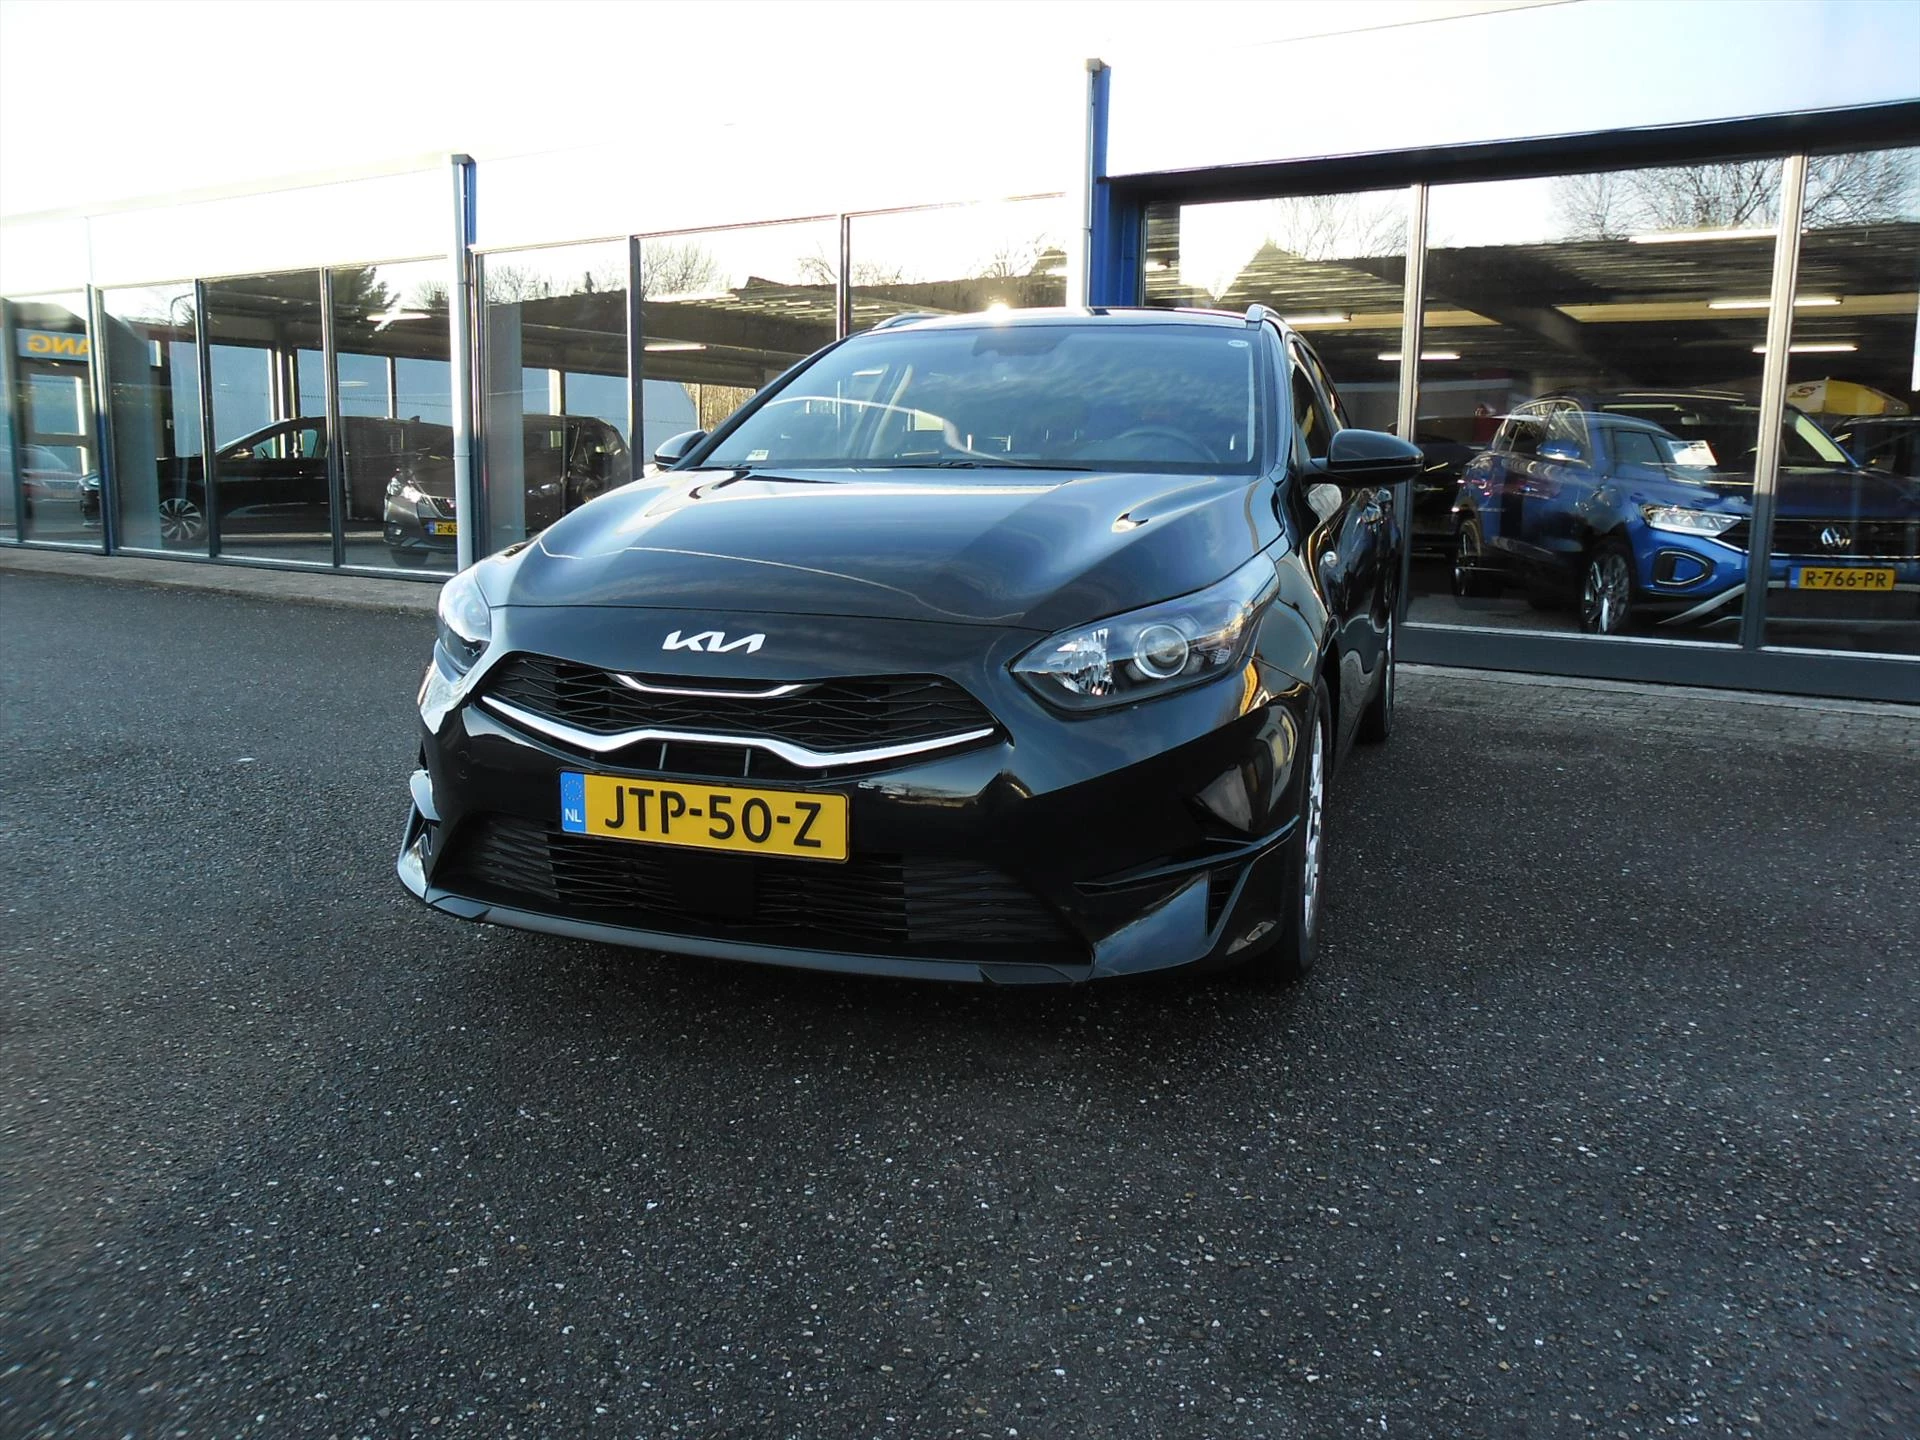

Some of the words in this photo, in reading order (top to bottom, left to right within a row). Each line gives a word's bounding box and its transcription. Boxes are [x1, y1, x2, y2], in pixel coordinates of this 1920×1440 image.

[1804, 570, 1887, 587] R-766-PR
[662, 630, 766, 654] KIA
[564, 808, 582, 823] NL
[605, 786, 821, 848] JTP-50-Z
